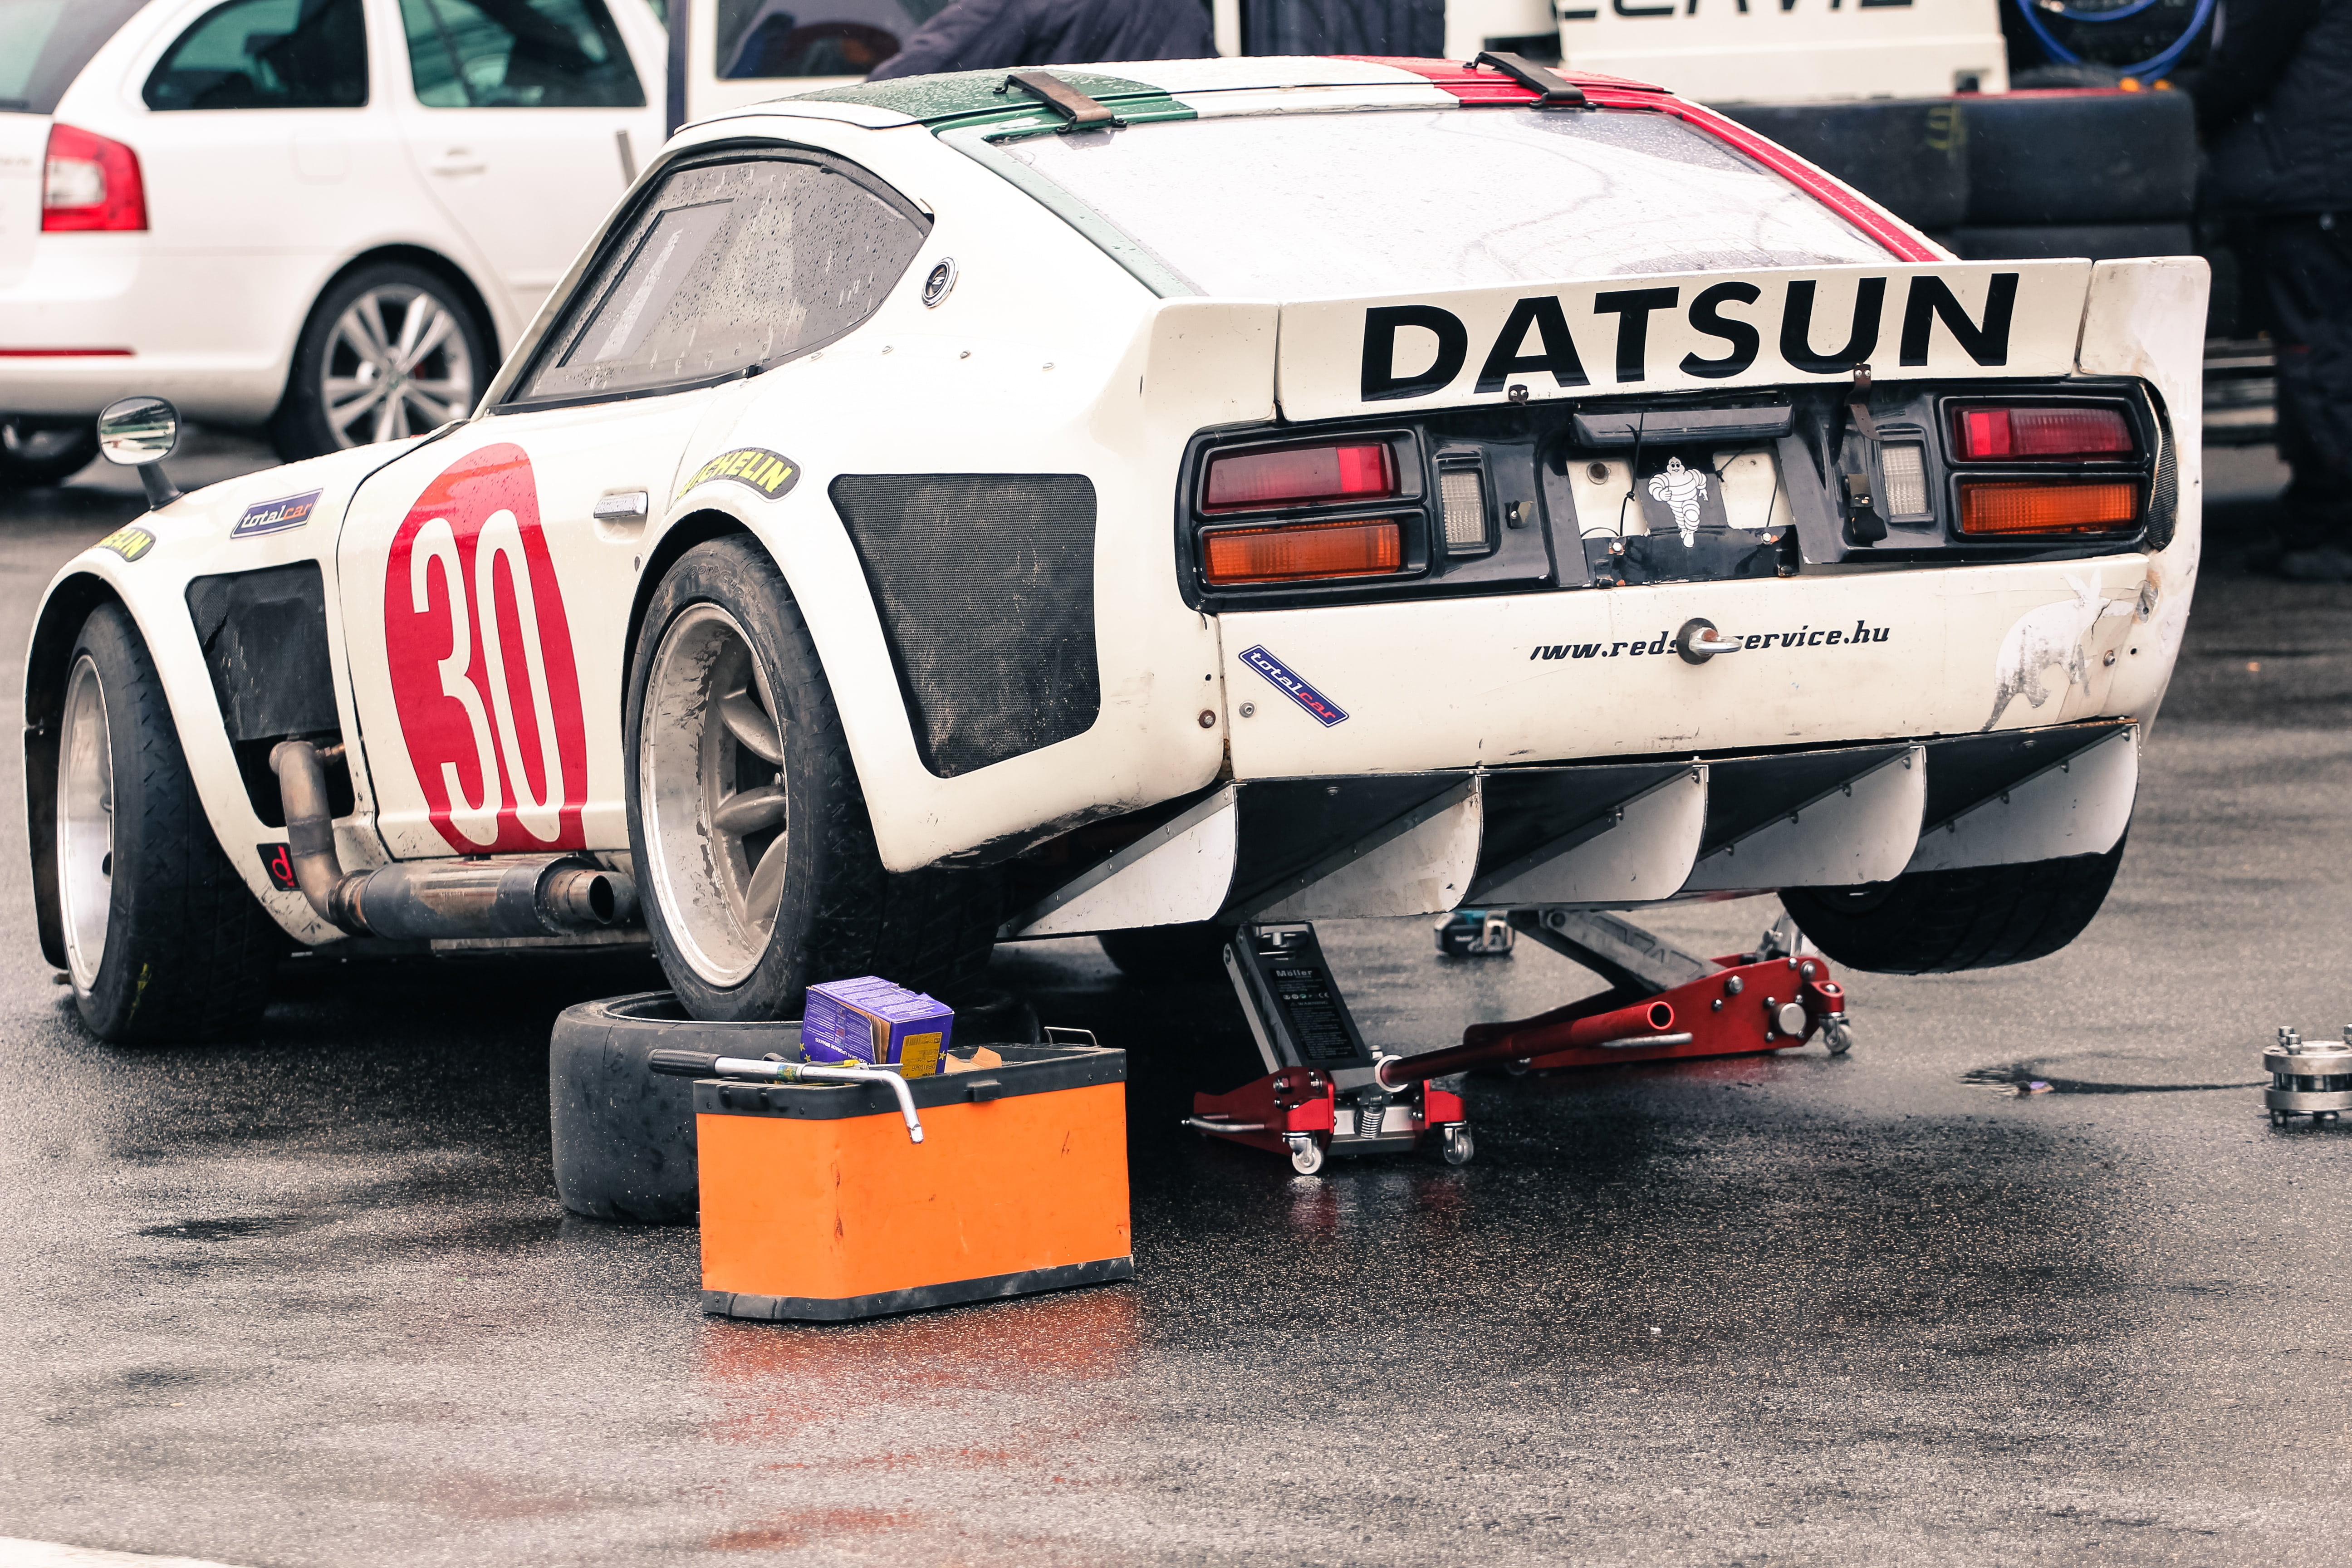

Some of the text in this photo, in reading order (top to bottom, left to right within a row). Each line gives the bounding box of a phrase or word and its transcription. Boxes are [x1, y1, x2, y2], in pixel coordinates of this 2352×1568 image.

[1361, 273, 2019, 402] DATSUN
[241, 502, 313, 529] totalcar
[1530, 620, 1890, 661] ww.redservice.hu
[410, 509, 565, 846] 30
[1250, 652, 1336, 718] totalcar
[815, 1037, 831, 1048] BRAKES
[830, 1044, 847, 1056] UPGRADE
